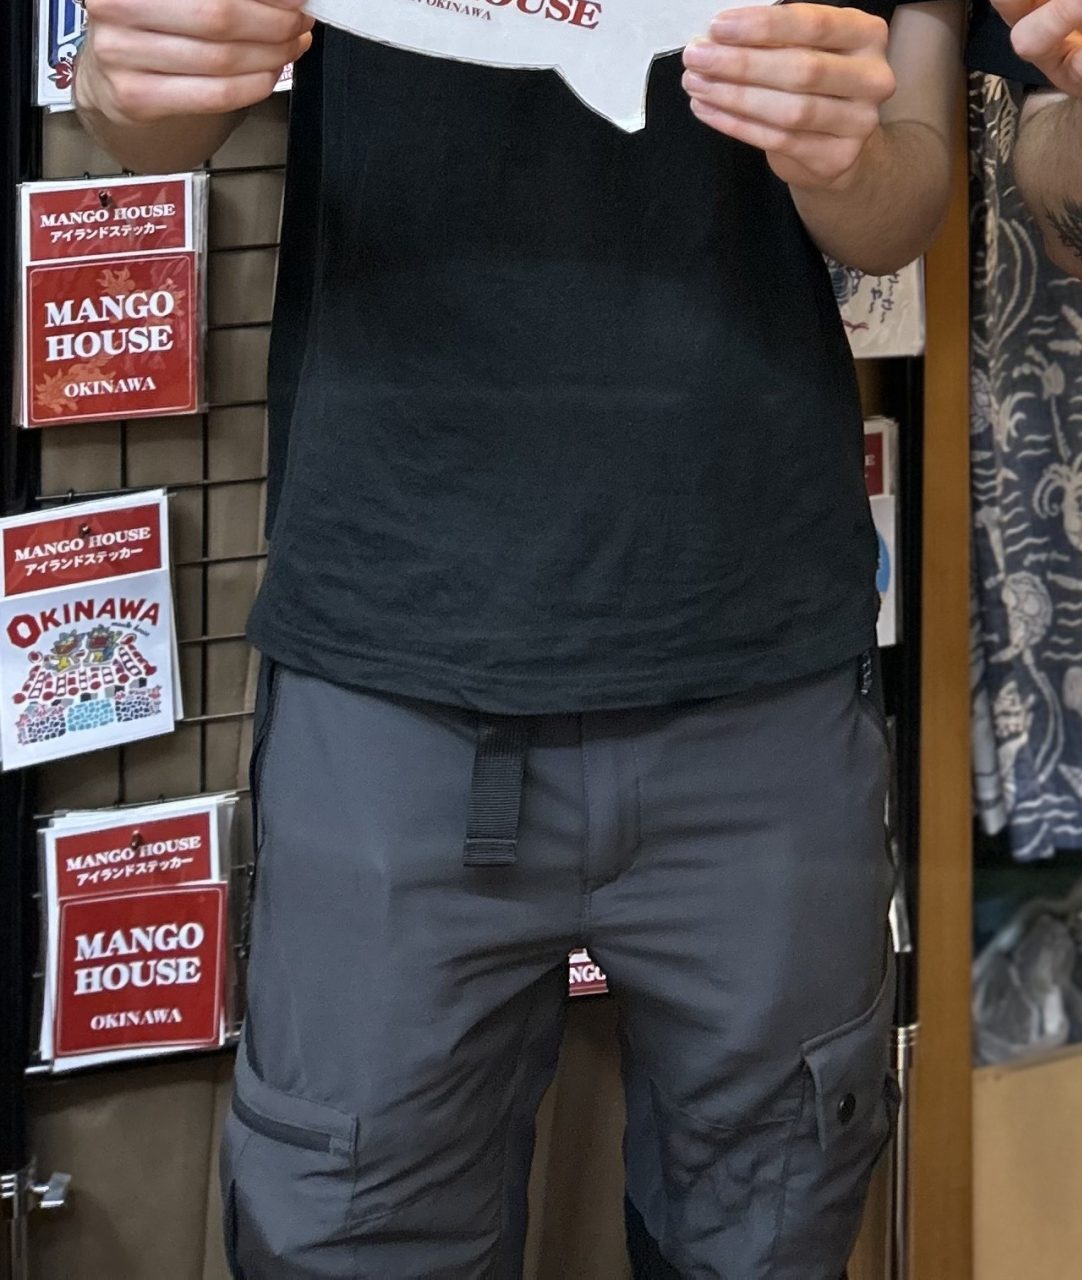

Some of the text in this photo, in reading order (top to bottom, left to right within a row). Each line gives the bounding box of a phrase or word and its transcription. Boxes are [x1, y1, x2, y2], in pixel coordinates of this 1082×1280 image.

[40, 203, 175, 227] MANGO HOUSE
[51, 222, 167, 243] アイランドステッカー
[44, 290, 175, 328] MANGO
[46, 325, 173, 362] HOUSE
[64, 376, 156, 398] OKINAWA
[15, 526, 151, 562] MANGO HOUSE
[25, 547, 143, 577] アイランドステッカー
[6, 598, 160, 648] OKINAWA
[66, 836, 201, 871] MANGO HOUSE
[77, 857, 193, 886] アイランドステッカー
[74, 922, 204, 962] MANGO
[74, 957, 201, 995] HOUSE
[90, 1008, 182, 1030] OKINAWA
